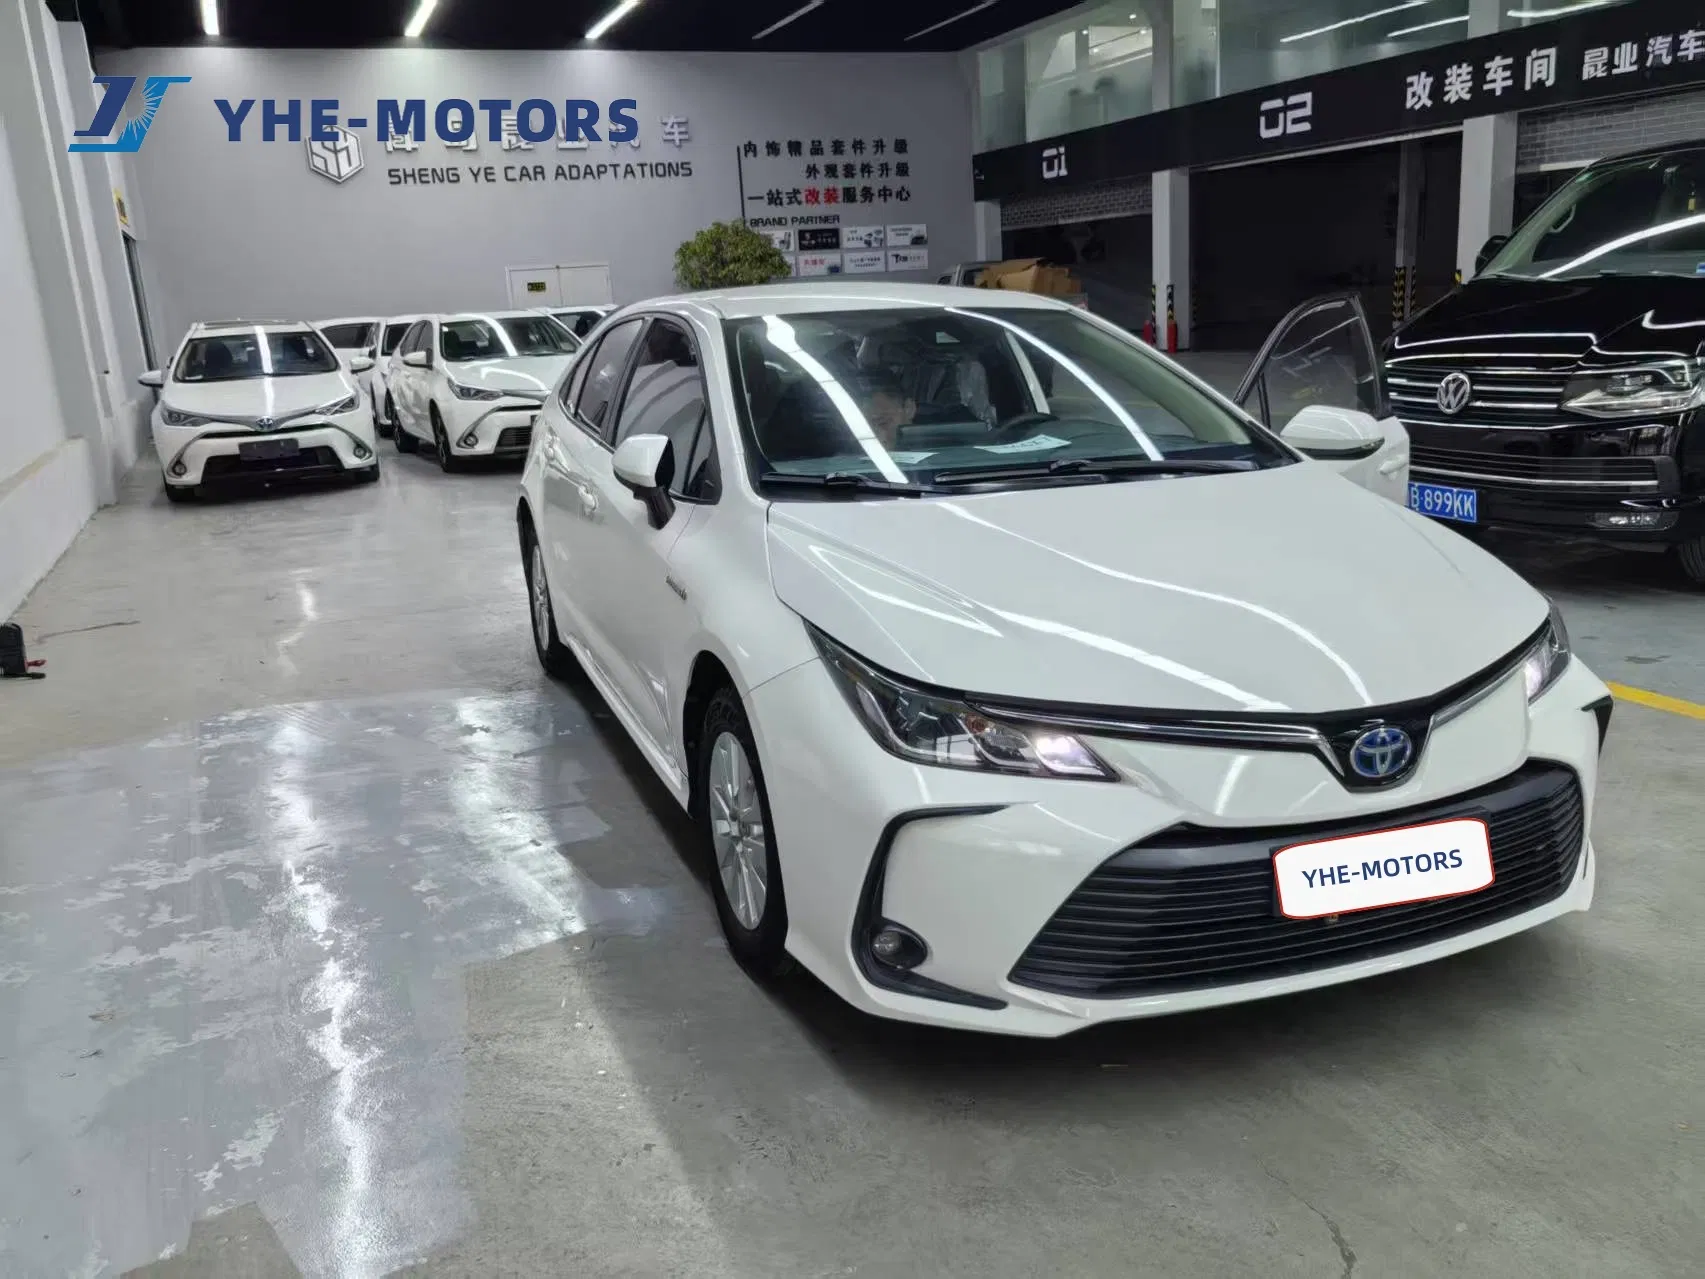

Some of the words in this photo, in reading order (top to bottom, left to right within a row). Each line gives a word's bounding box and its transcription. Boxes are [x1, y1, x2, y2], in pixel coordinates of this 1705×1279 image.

[1405, 46, 1556, 110] 改装车间
[1259, 92, 1313, 138] 02
[743, 138, 909, 158] 内饰精品套件升级
[388, 168, 461, 184] SHENG
[469, 168, 497, 182] YE
[504, 166, 546, 181] CAR
[555, 162, 694, 180] ADAPTATIONS
[805, 162, 910, 180] 外观套件升级
[1042, 147, 1068, 180] 01
[747, 187, 911, 206] 一站式改装服务中心
[750, 217, 787, 227] BRAND
[791, 215, 840, 226] PARTNER
